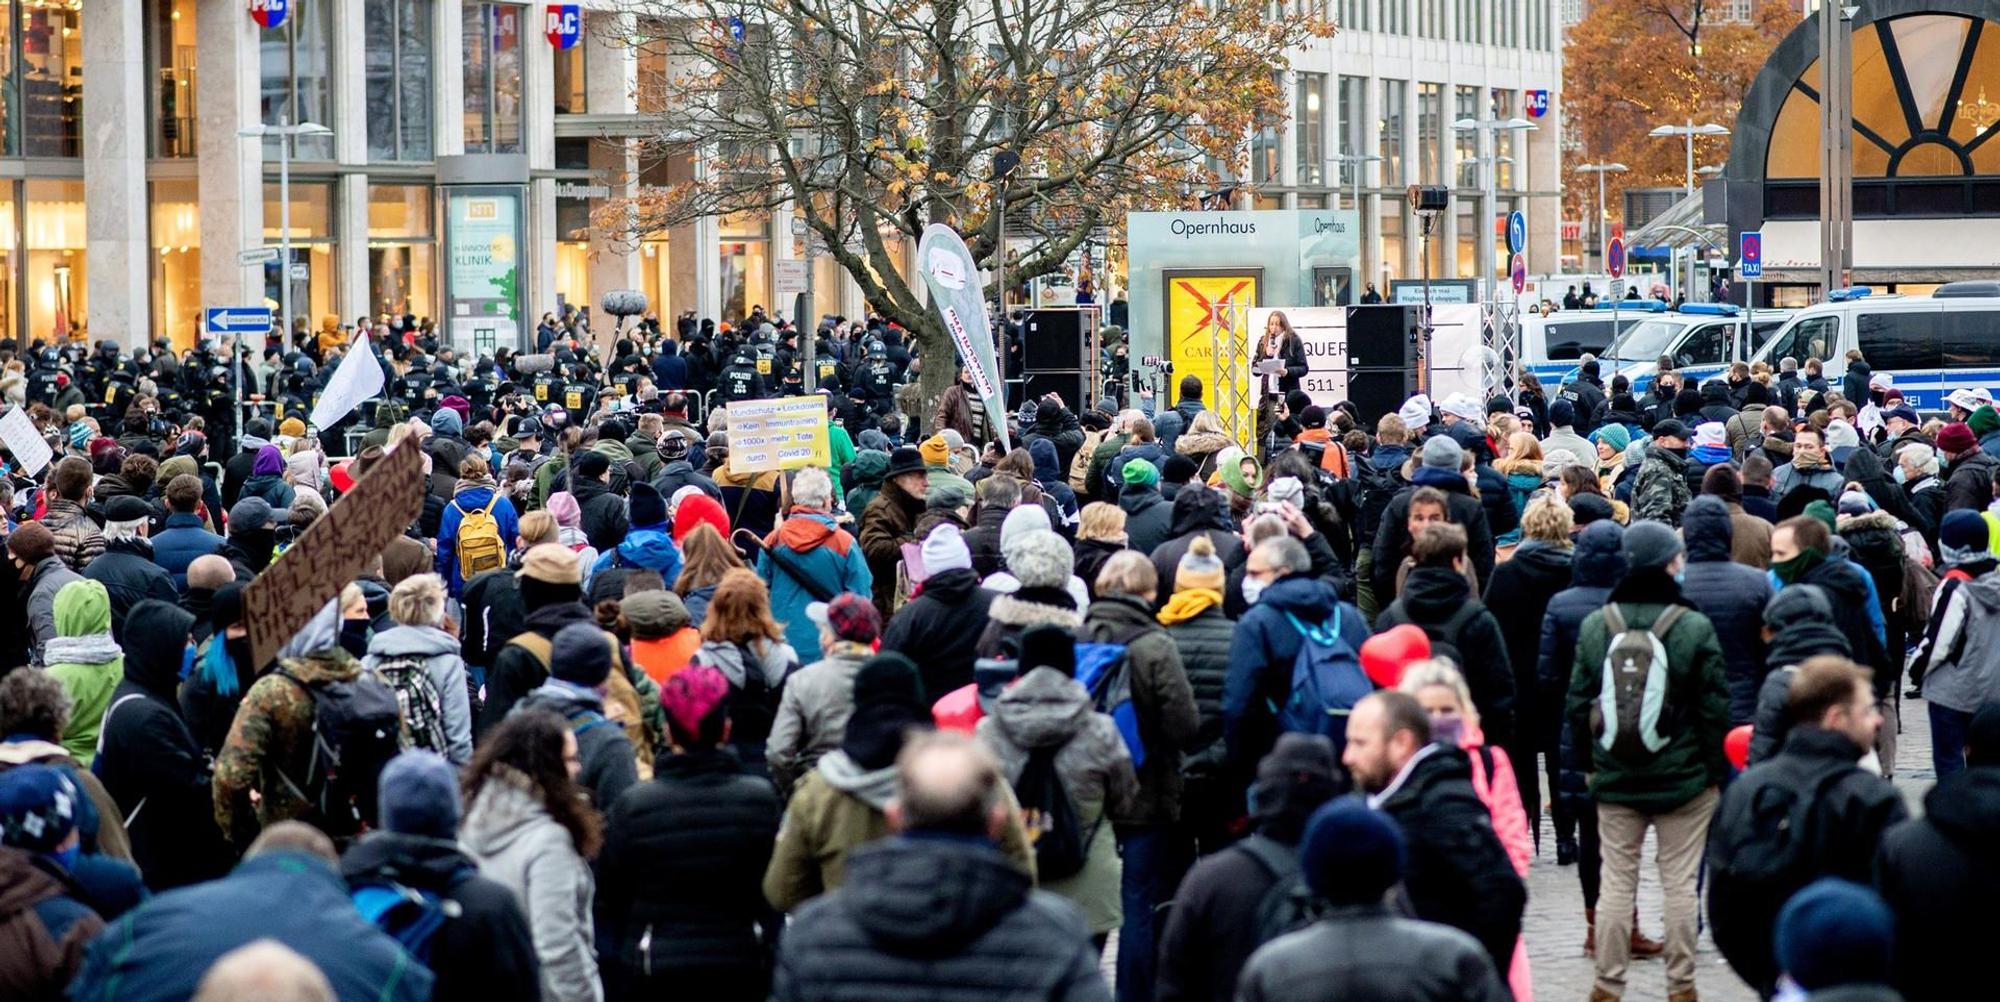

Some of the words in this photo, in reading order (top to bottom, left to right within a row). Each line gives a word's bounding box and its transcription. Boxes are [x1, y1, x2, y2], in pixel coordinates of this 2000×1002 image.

[547, 12, 576, 34] P&C
[1526, 94, 1546, 109] P&C
[1170, 216, 1256, 239] Opernhaus
[1314, 216, 1345, 234] Opernhaus
[455, 255, 492, 266] KLINIK
[1743, 263, 1760, 273] TAXI
[1548, 326, 1557, 335] 10
[1303, 342, 1347, 357] QUER
[730, 372, 752, 381] POLIZEI
[1307, 379, 1335, 392] 511
[1562, 390, 1579, 402] POLIZEI
[782, 401, 824, 411] Lockdowns
[743, 438, 764, 446] 1000x
[745, 454, 767, 462] durch
[778, 450, 800, 458] Covid
